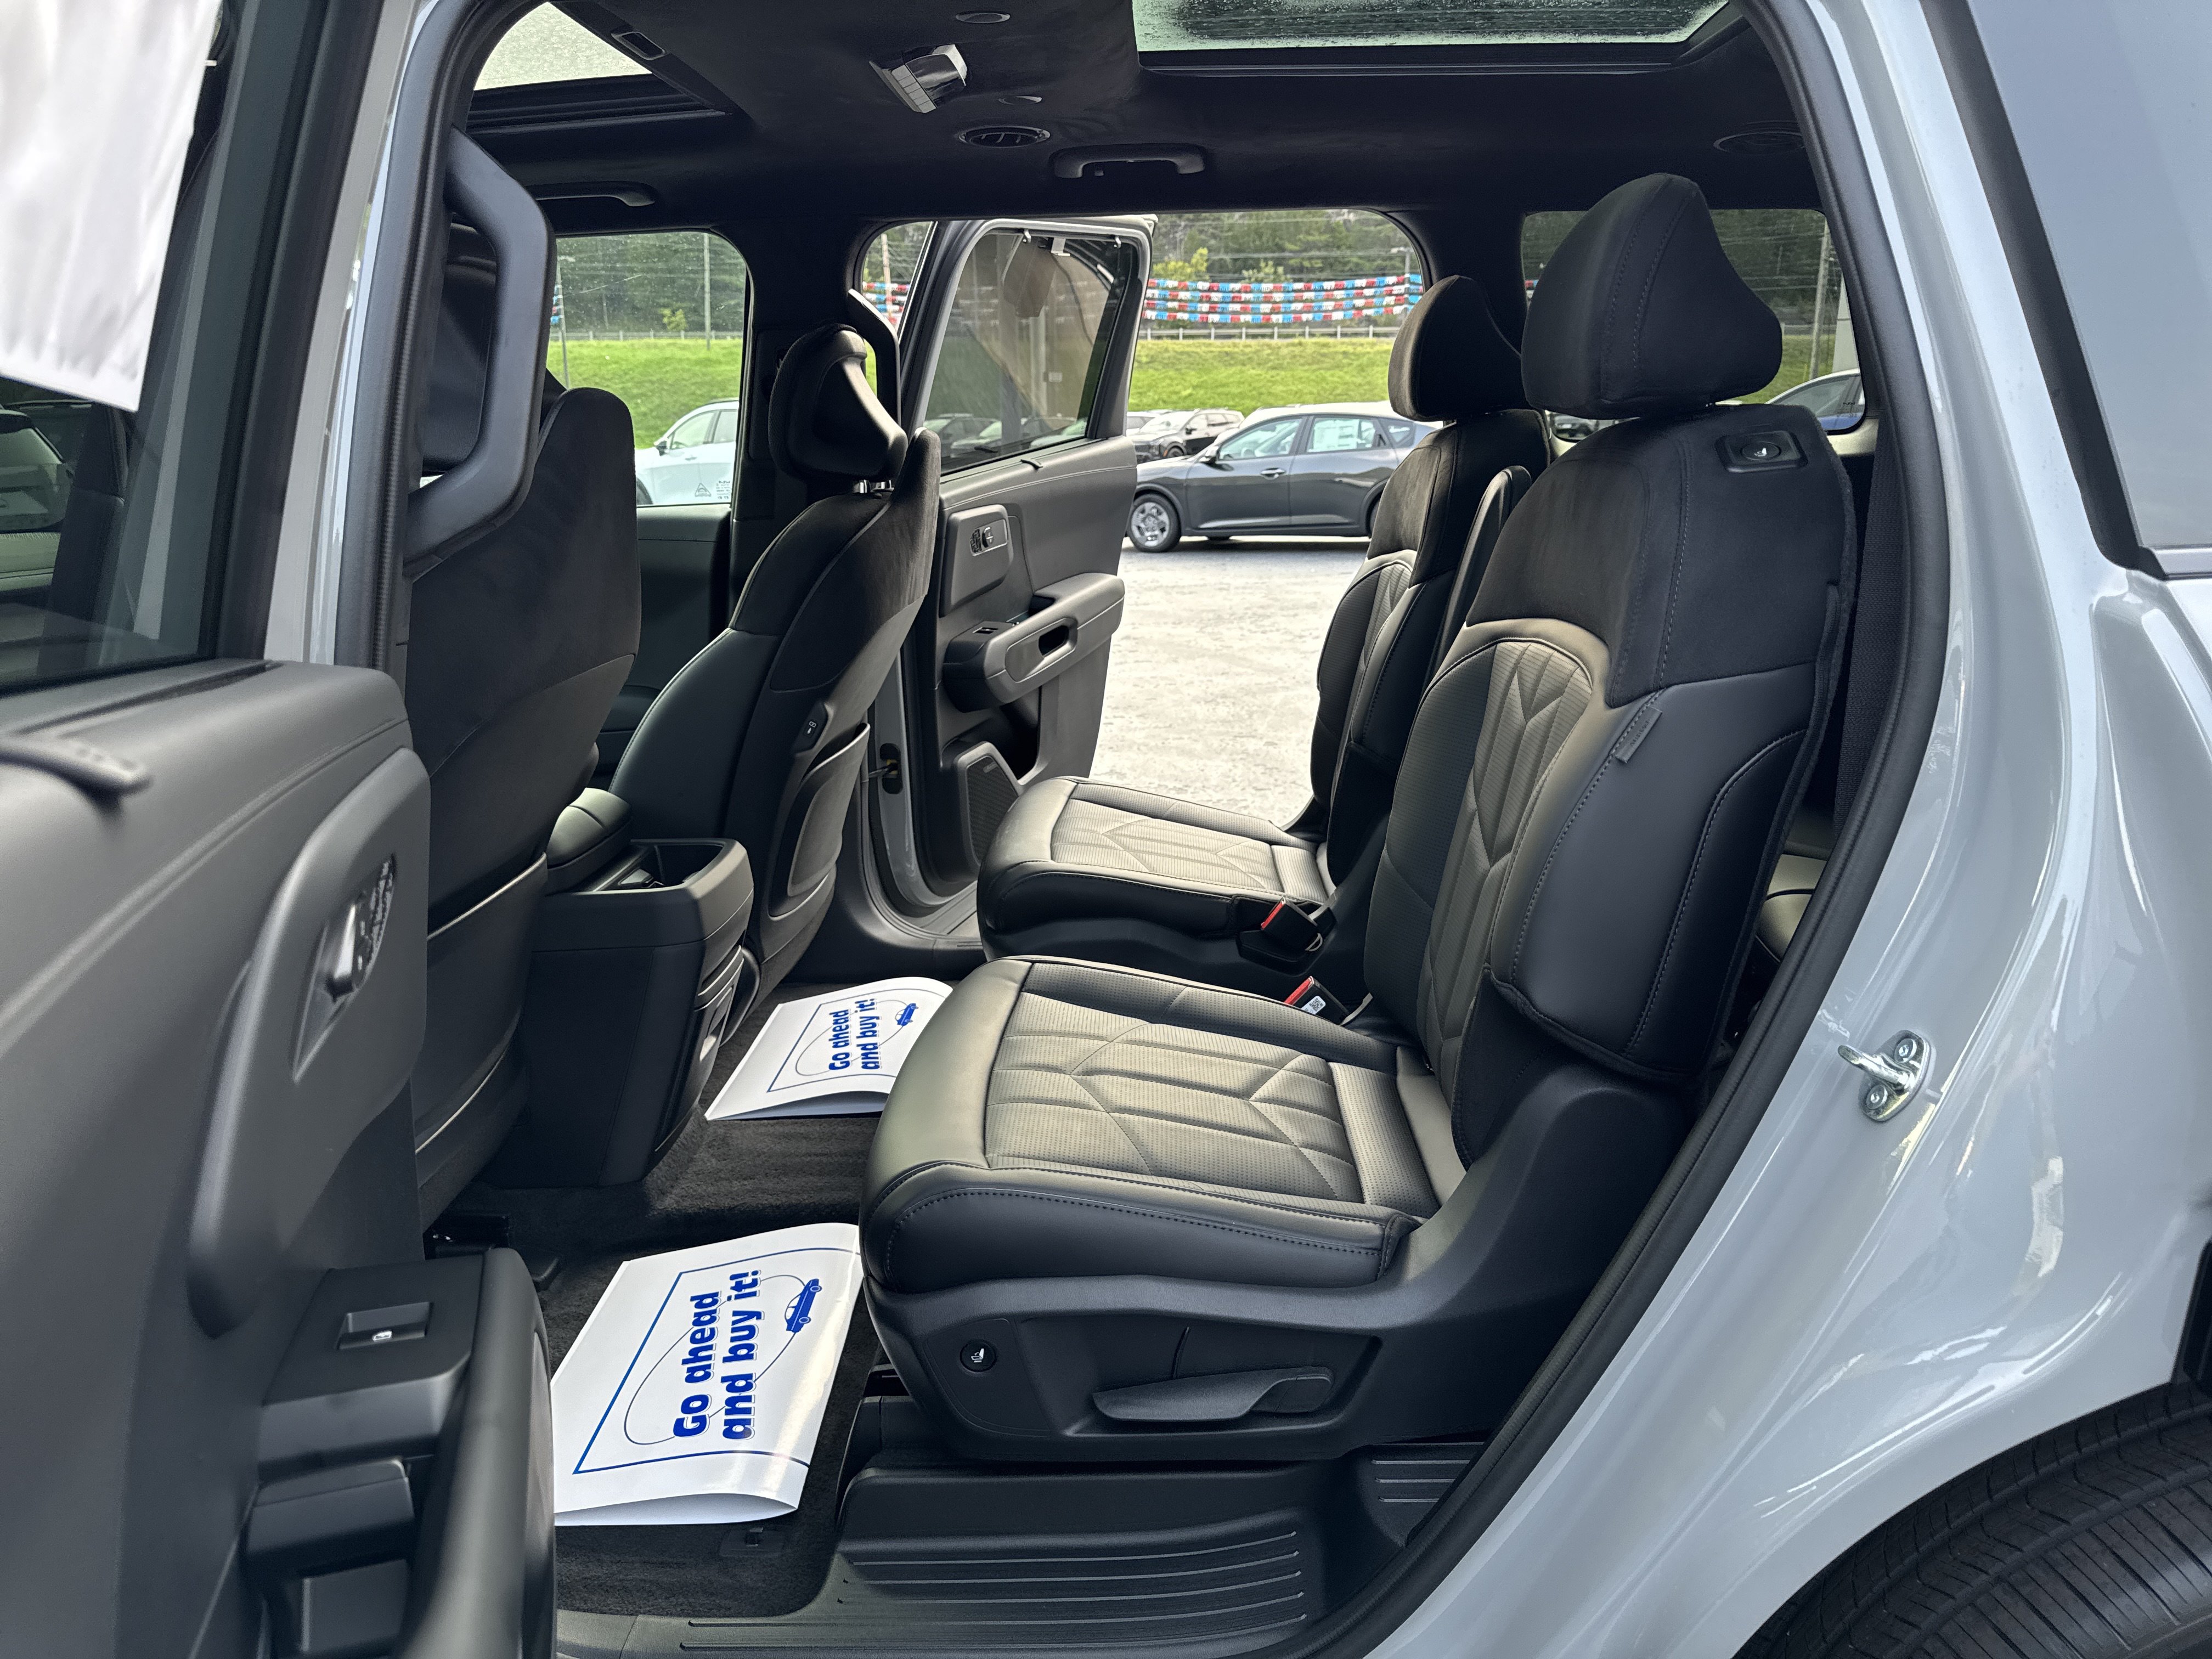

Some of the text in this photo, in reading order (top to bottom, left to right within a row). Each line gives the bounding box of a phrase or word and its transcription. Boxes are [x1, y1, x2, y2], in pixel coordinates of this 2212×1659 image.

[828, 1009, 851, 1070] Go ahead
[854, 998, 881, 1070] and buy it!
[673, 1291, 721, 1438] Go ahead
[720, 1269, 764, 1440] and buy it!
